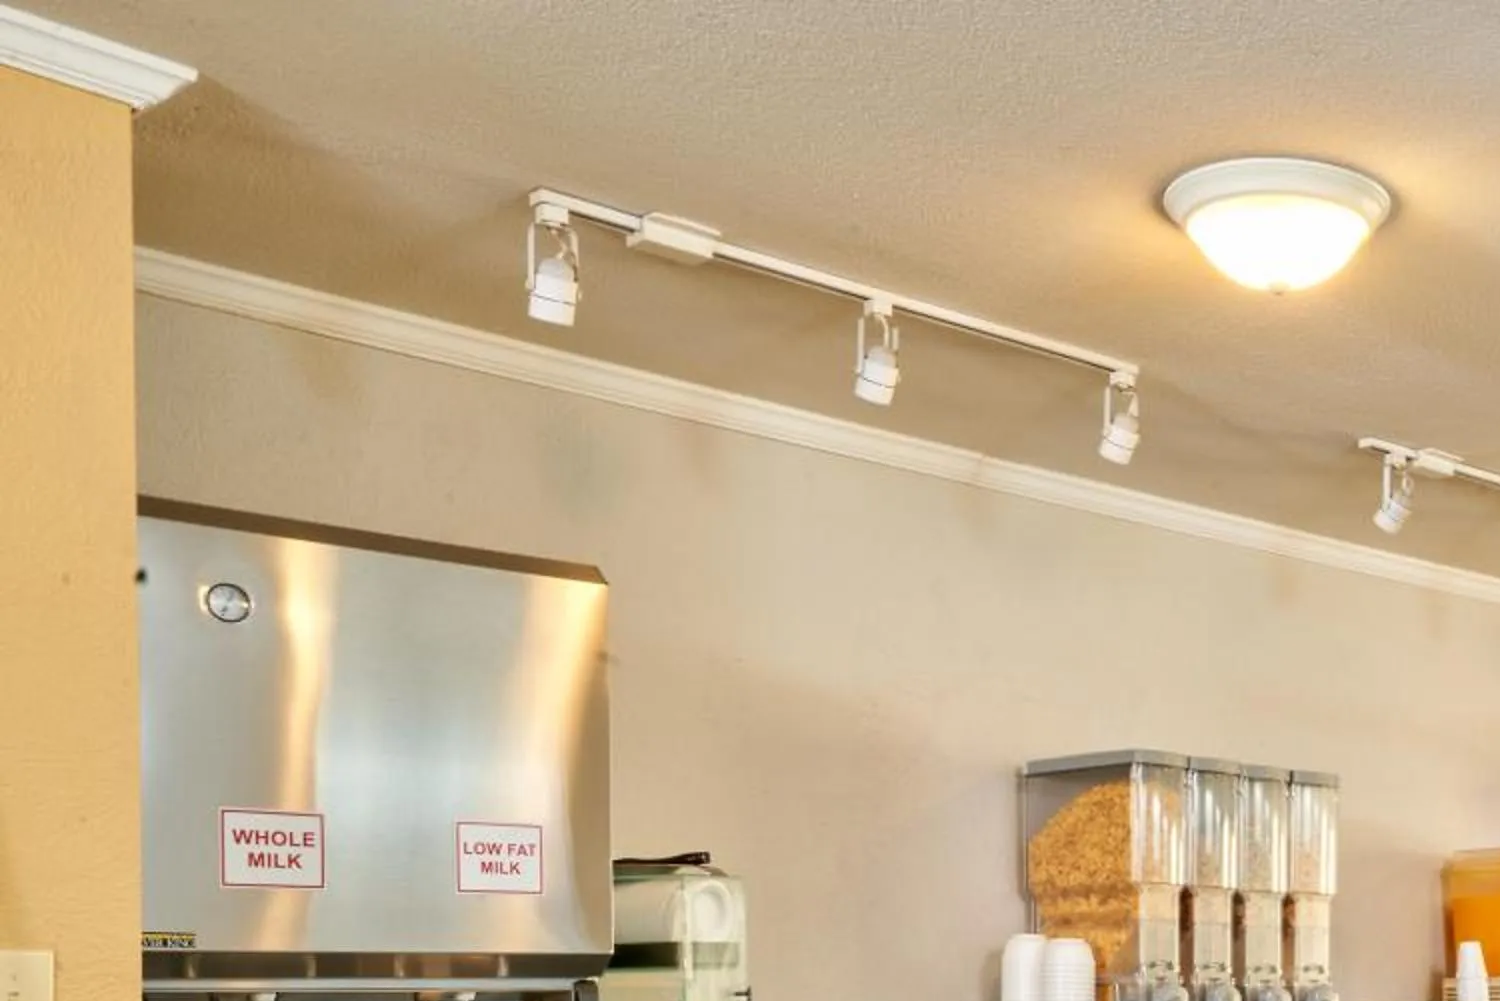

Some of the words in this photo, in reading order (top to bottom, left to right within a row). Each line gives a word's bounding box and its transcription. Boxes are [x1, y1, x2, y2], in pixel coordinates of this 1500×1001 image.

[232, 829, 316, 848] WHOLE
[463, 842, 503, 856] LOW
[507, 843, 536, 857] FAT
[247, 851, 303, 869] MILK
[480, 861, 521, 876] MILK
